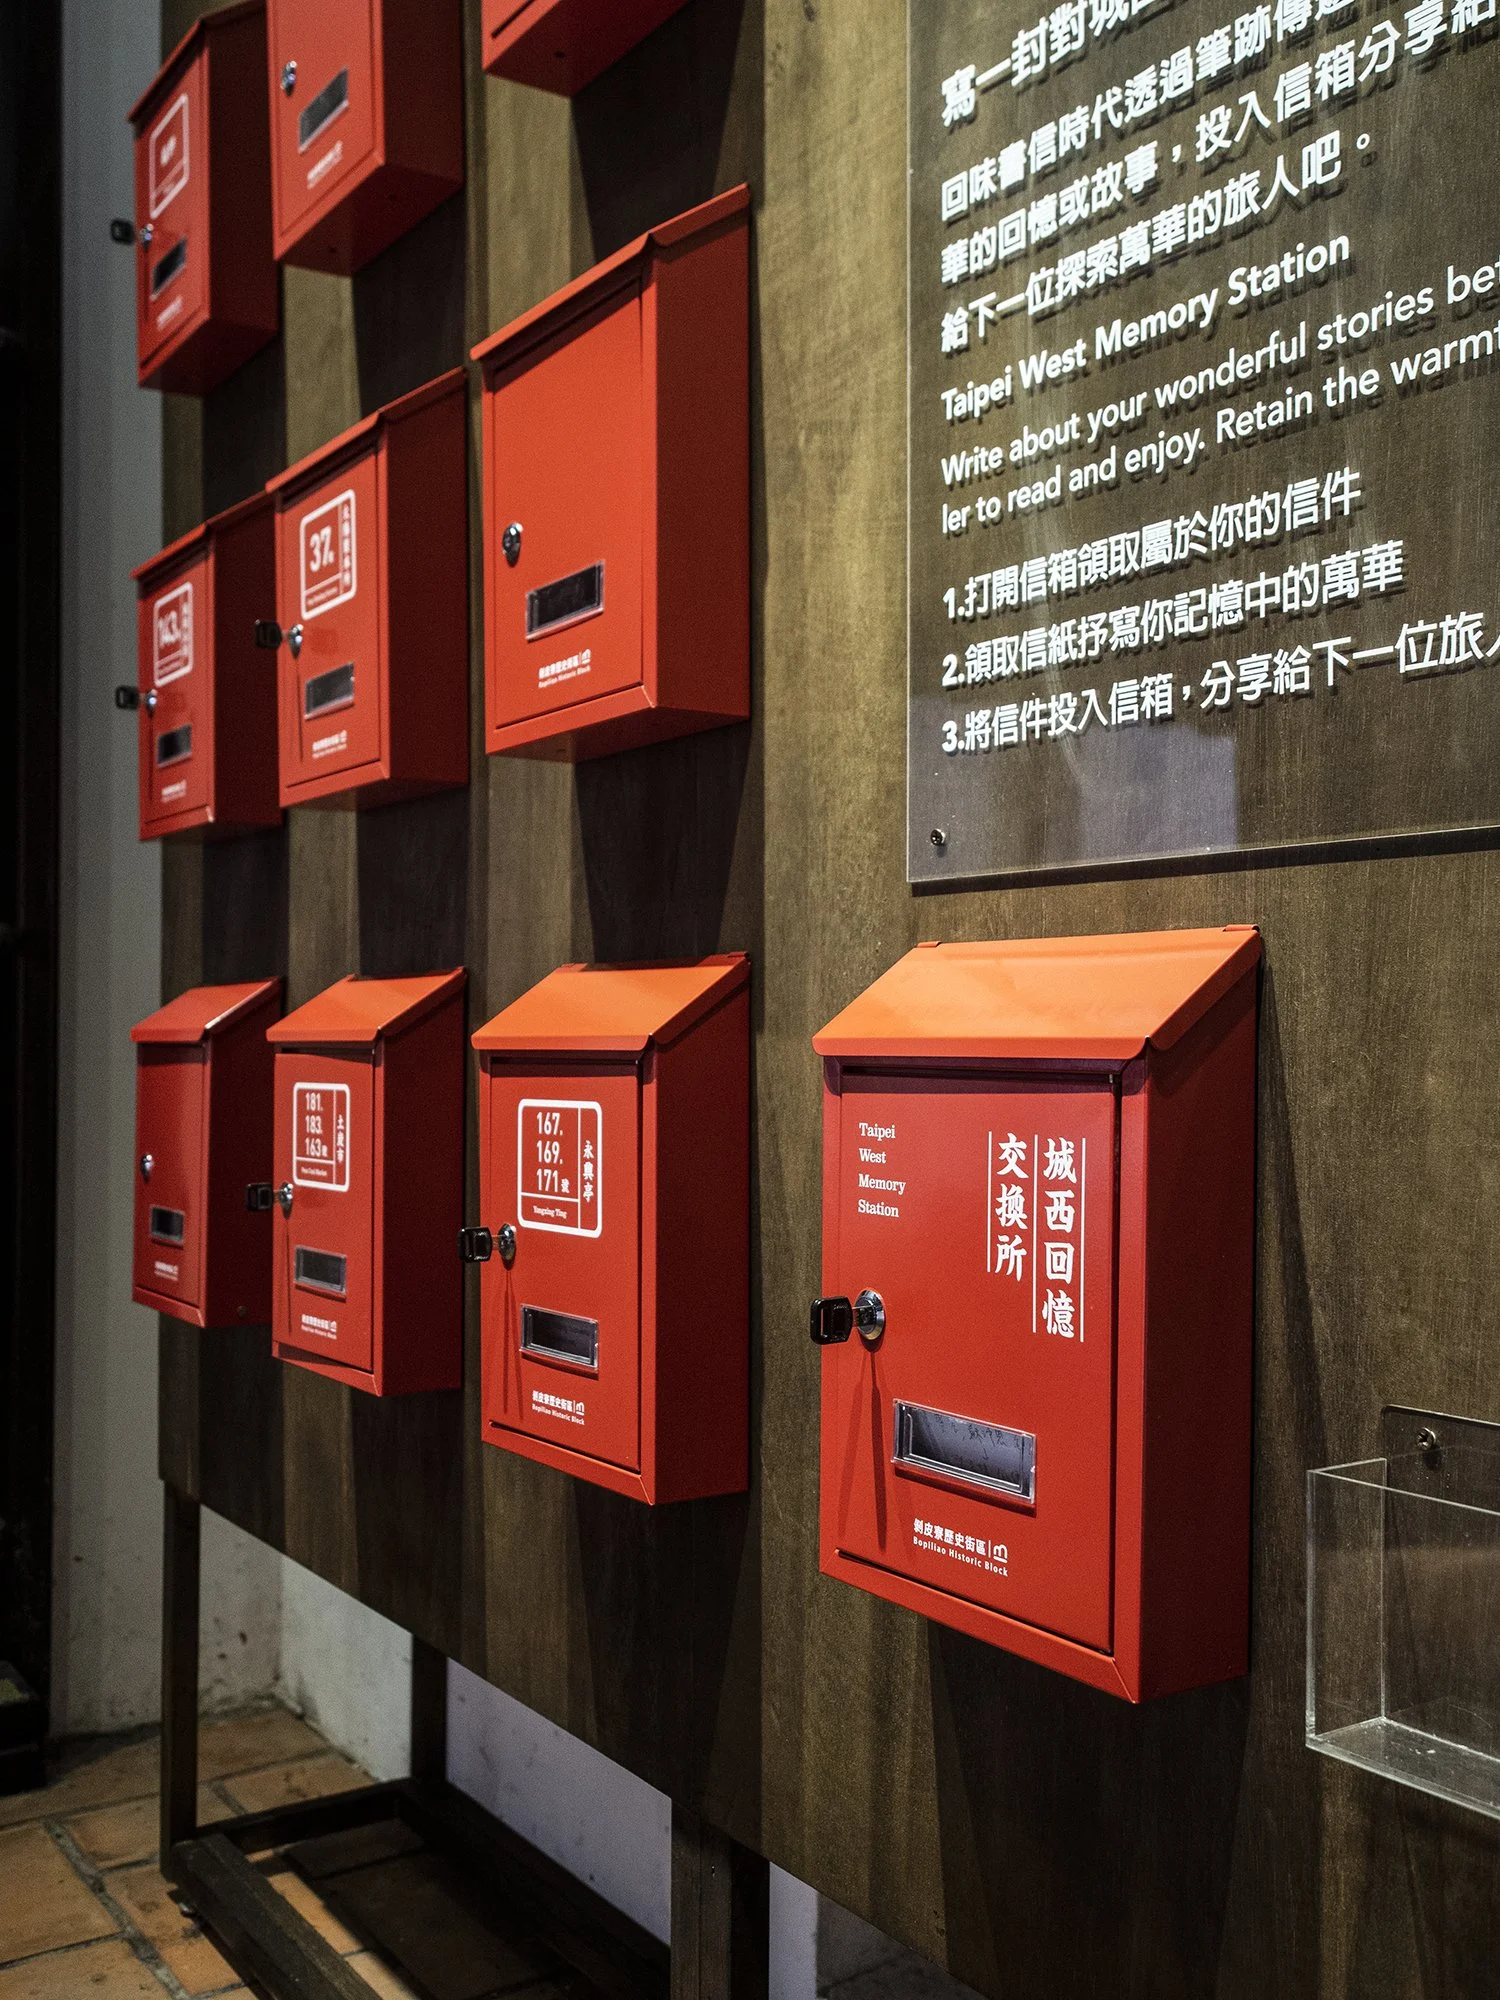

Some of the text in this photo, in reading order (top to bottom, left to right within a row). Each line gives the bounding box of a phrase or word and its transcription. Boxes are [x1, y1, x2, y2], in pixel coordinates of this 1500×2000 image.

[941, 0, 1154, 127] 寫一封對城
[941, 130, 1371, 353] 給下一位探索萬華的旅人吧。
[940, 235, 1349, 421] Taipei West Memory Station
[941, 446, 1004, 485] Write
[1009, 412, 1080, 462] about
[1087, 392, 1148, 444] your
[1154, 321, 1306, 408] wonderful
[1317, 290, 1435, 351] stories
[942, 503, 972, 534] ler
[975, 496, 1002, 522] to
[1008, 464, 1062, 513] read
[1068, 445, 1117, 492] and
[1124, 428, 1206, 474] enjoy.
[1216, 387, 1313, 444] Retain
[1322, 366, 1380, 407] the
[942, 467, 1362, 619] 1.打開信箱領取屬於你的信件
[942, 540, 1404, 687] 2.領取信紙抒寫你記憶中的萬華
[941, 611, 1500, 753] 3.將信件投入信箱，分享給下一位旅
[858, 1122, 896, 1142] Taipei
[858, 1147, 887, 1164] West
[858, 1173, 907, 1196] Memory
[857, 1198, 900, 1218] Station
[994, 1132, 1029, 1282] 交換所
[1042, 1135, 1078, 1339] 城西回憶
[913, 1535, 1008, 1577] Bopiliao Historic Block
